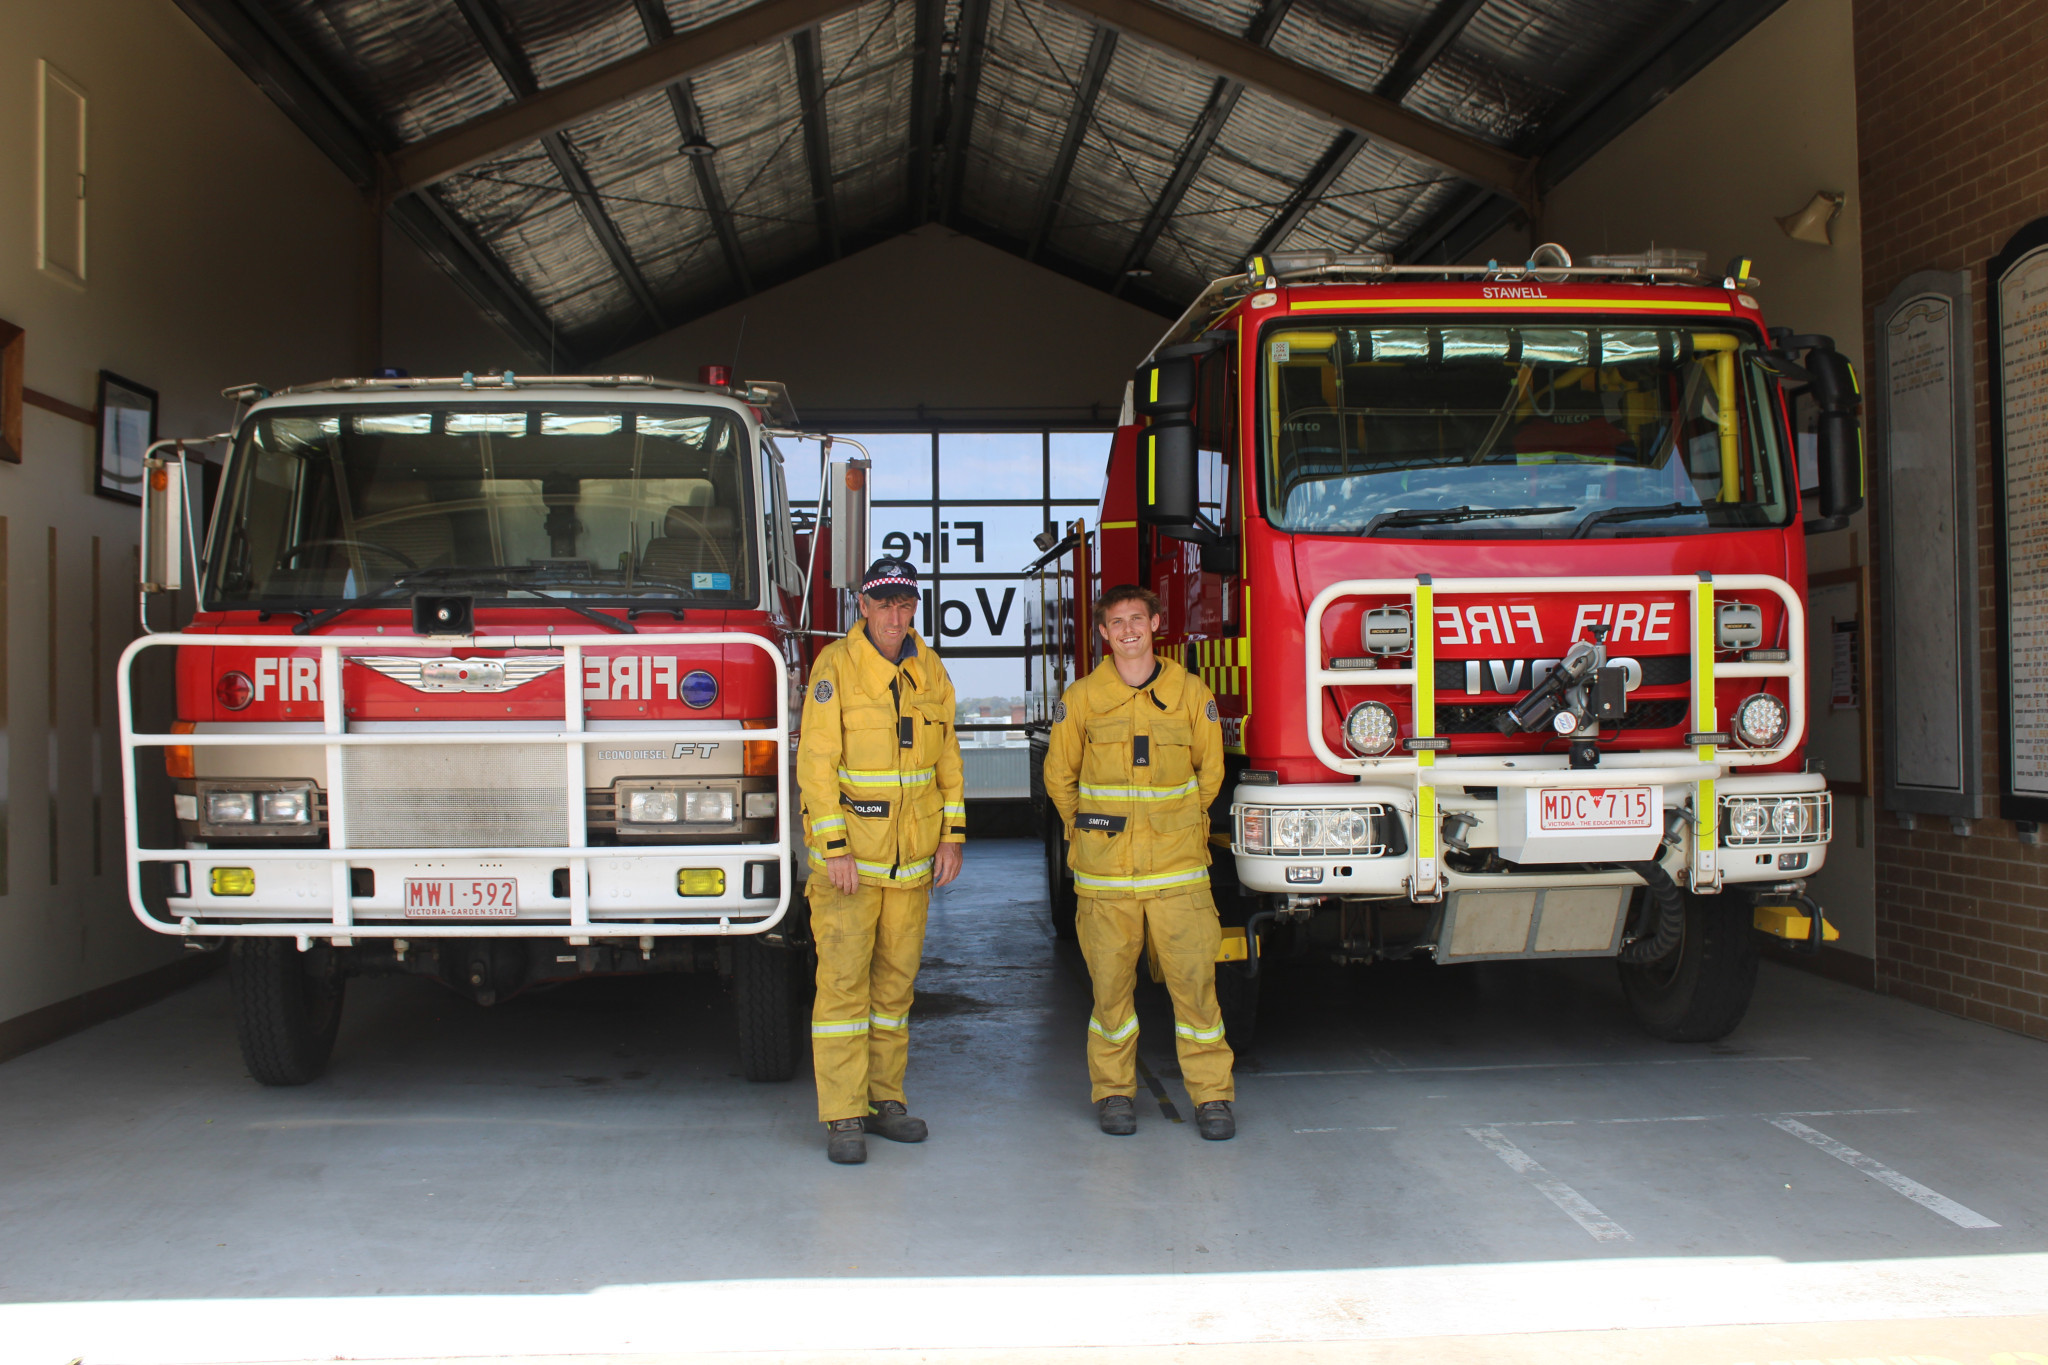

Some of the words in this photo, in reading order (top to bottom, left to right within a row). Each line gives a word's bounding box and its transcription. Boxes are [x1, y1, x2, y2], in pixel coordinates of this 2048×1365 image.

[1482, 287, 1548, 299] STAWELL
[1553, 414, 1590, 424] IVECO
[1283, 422, 1321, 432] IVECO
[1570, 602, 1675, 643] FIRE
[255, 657, 324, 701] FIR
[598, 750, 632, 760] ECONO
[633, 750, 668, 760] DIESEL
[671, 742, 720, 759] FT
[1545, 795, 1587, 820] MDC
[1606, 793, 1647, 818] 715
[1088, 818, 1110, 827] SMITH
